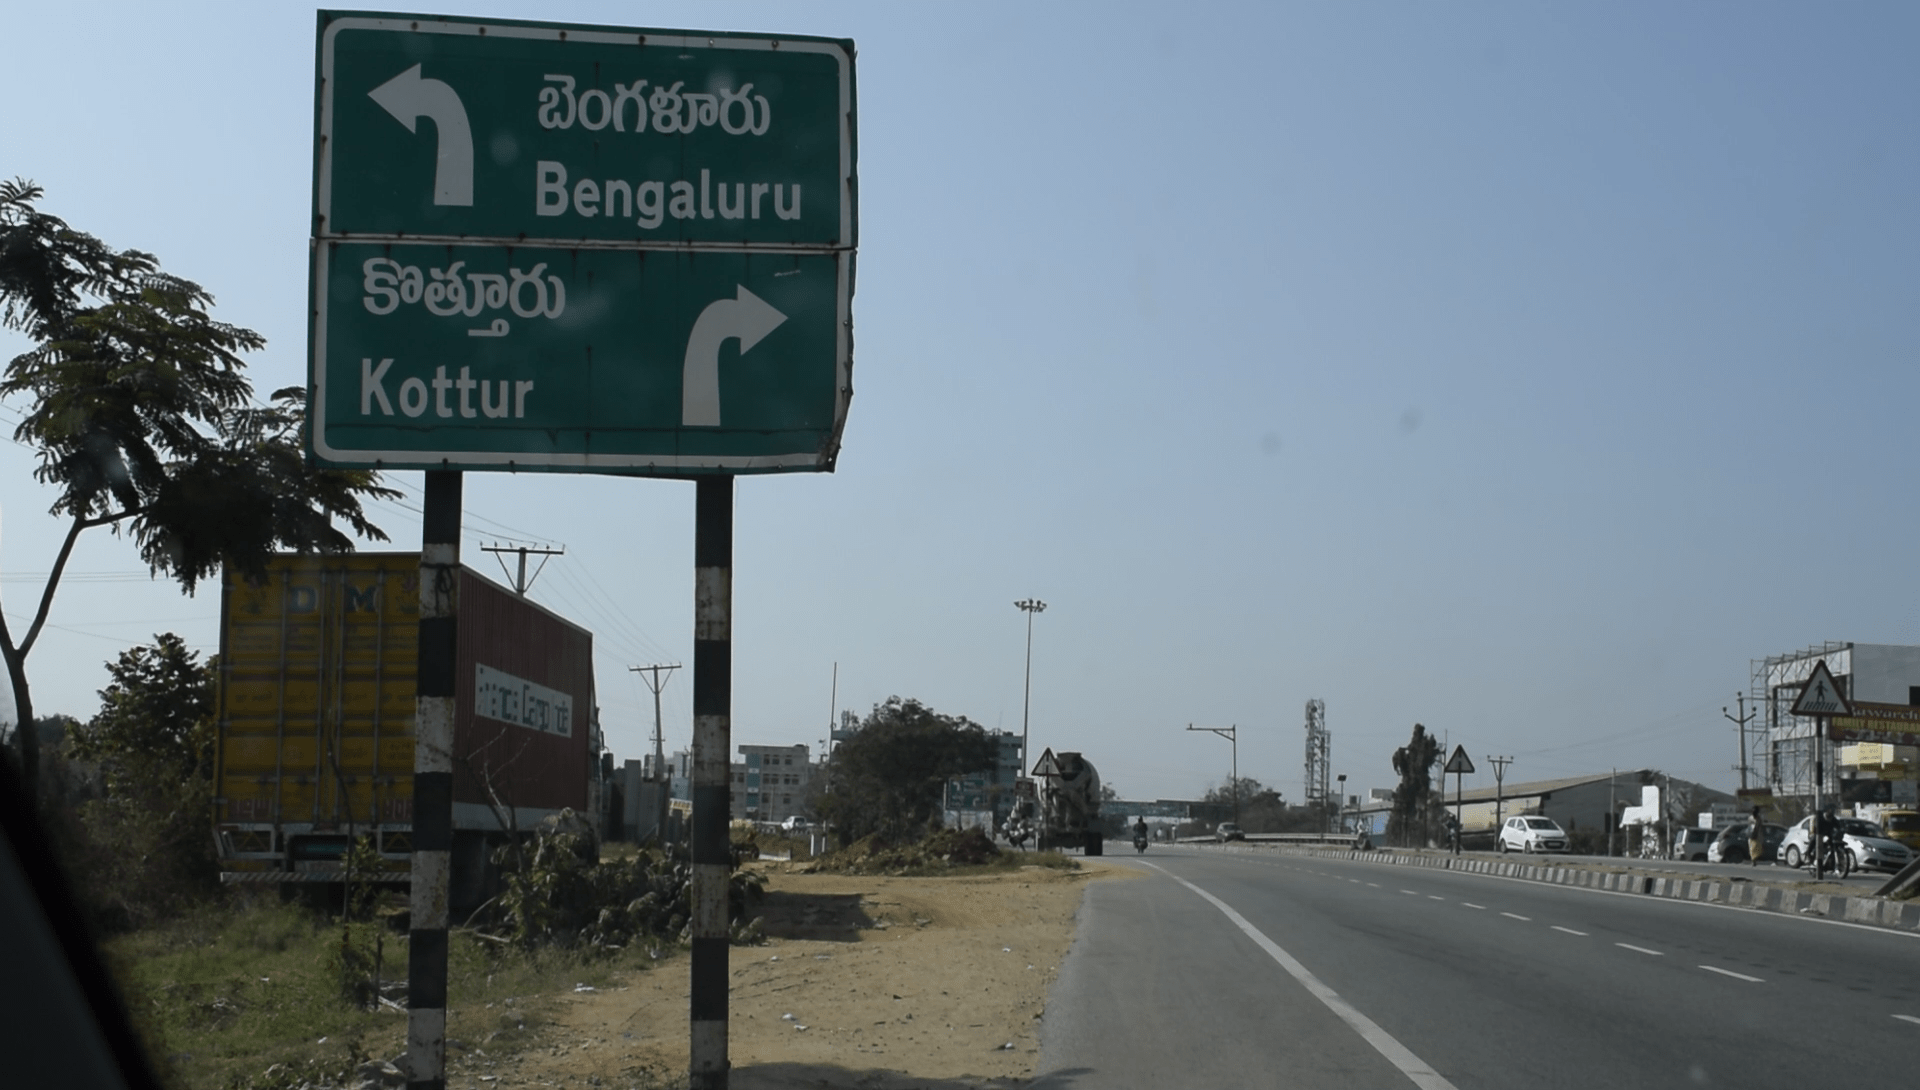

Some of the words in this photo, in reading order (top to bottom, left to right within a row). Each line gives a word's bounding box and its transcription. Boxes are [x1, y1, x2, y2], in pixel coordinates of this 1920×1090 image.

[538, 73, 771, 136] బెంగళూరు
[536, 160, 801, 229] Bengaluru
[362, 257, 566, 337] కొత్తూరు
[361, 357, 534, 419] Kottur
